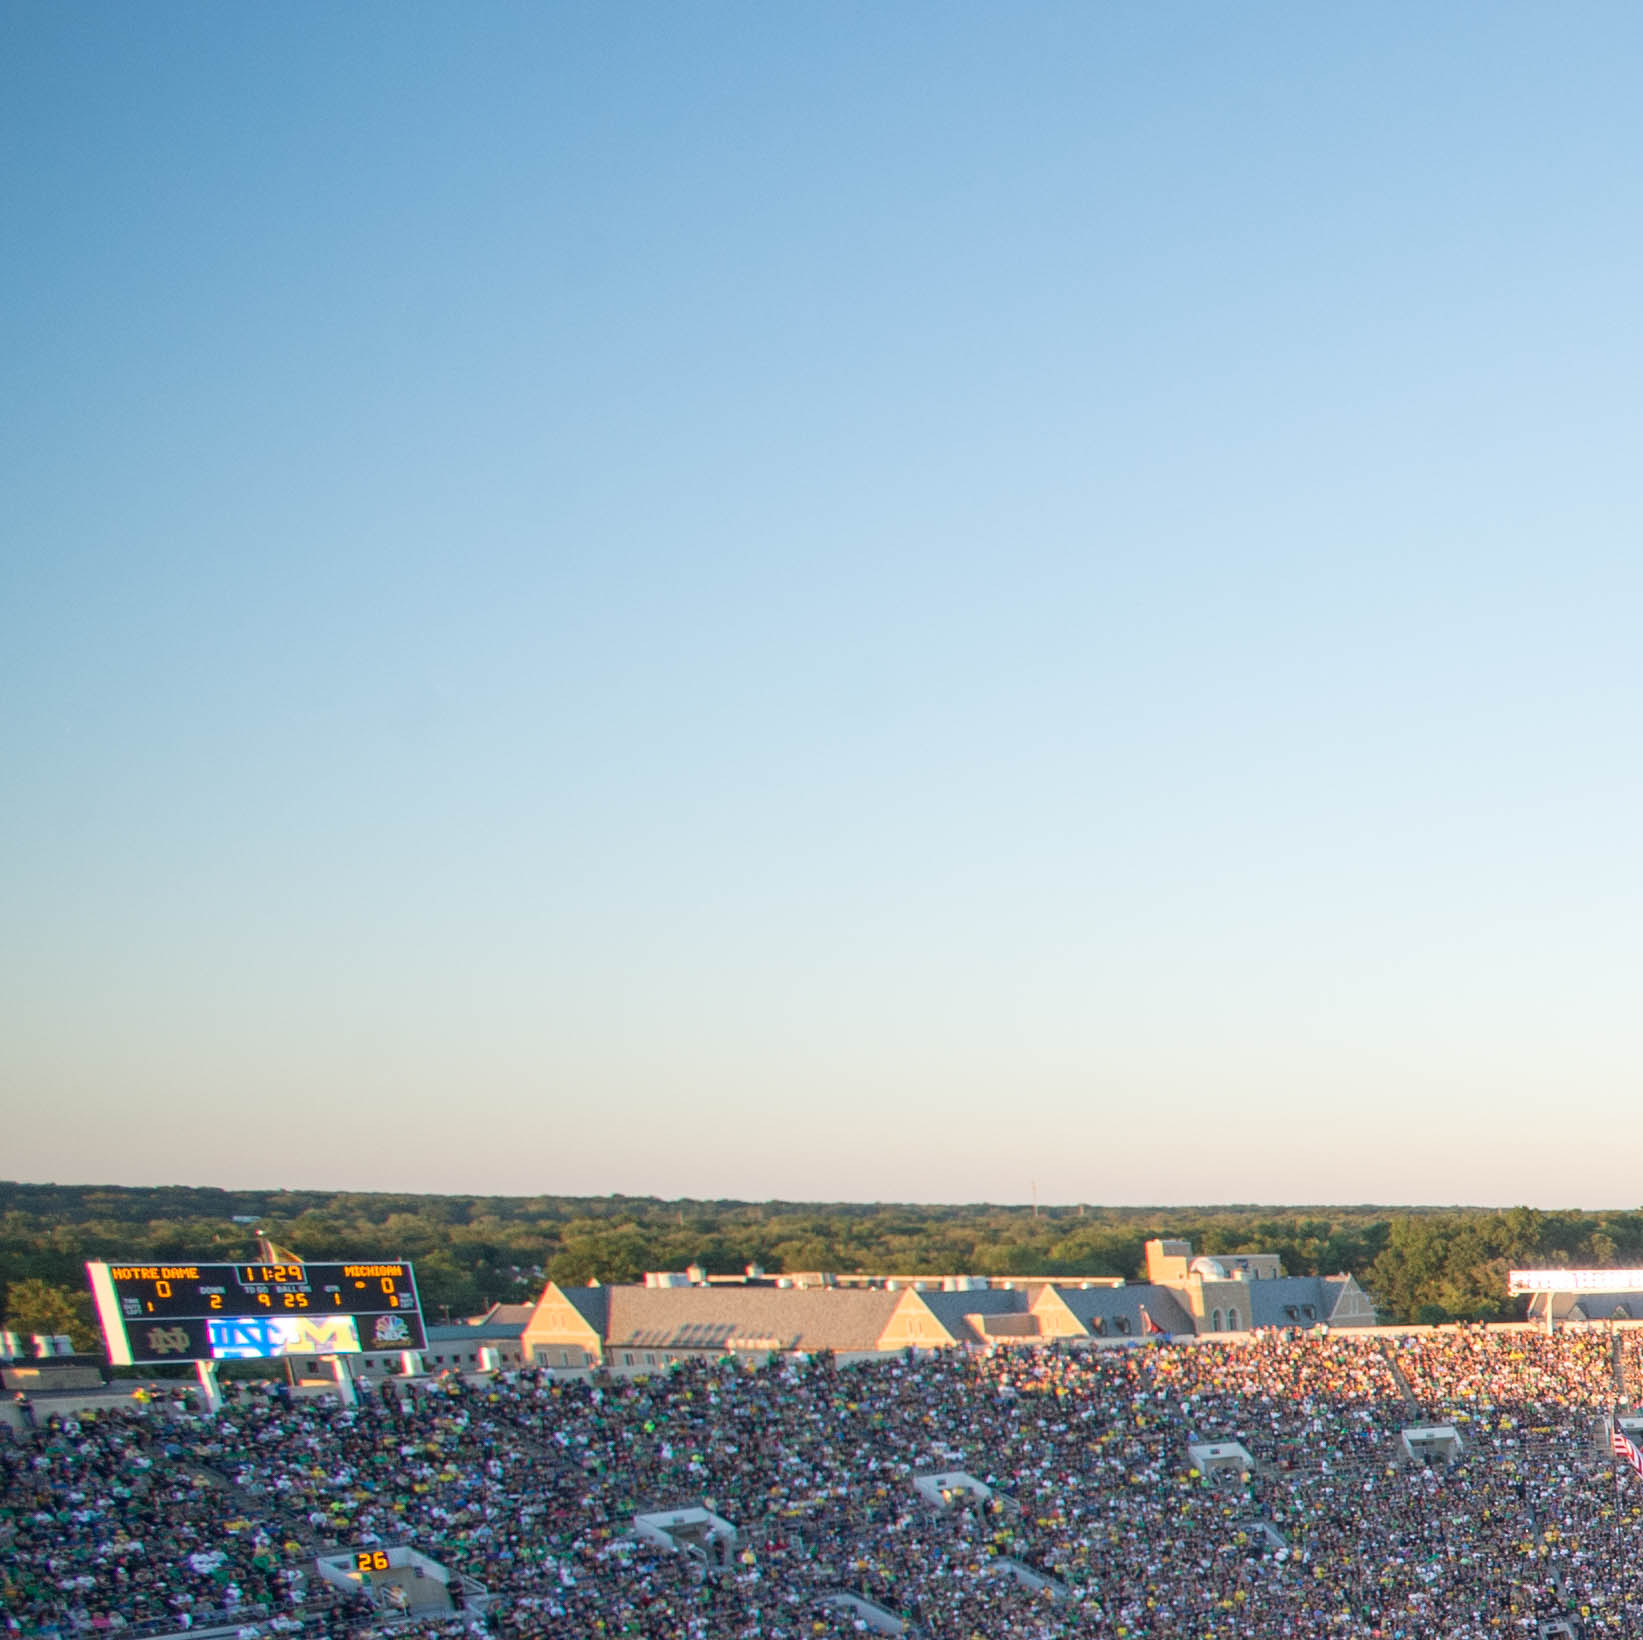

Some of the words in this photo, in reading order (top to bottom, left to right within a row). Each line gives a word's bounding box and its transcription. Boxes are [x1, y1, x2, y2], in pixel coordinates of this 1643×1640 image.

[112, 1267, 160, 1280] NOTRE
[161, 1267, 200, 1280] DAME
[246, 1265, 302, 1282] 11:29
[344, 1265, 403, 1278] MICHIGAN
[155, 1281, 173, 1298] 0
[381, 1277, 395, 1293] 0
[210, 1294, 223, 1309] 2
[258, 1293, 271, 1307] 9
[283, 1293, 309, 1308] 25
[333, 1292, 342, 1305] 1
[146, 1301, 155, 1312] 1
[376, 1330, 409, 1341] NBC
[355, 1552, 390, 1571] 26
